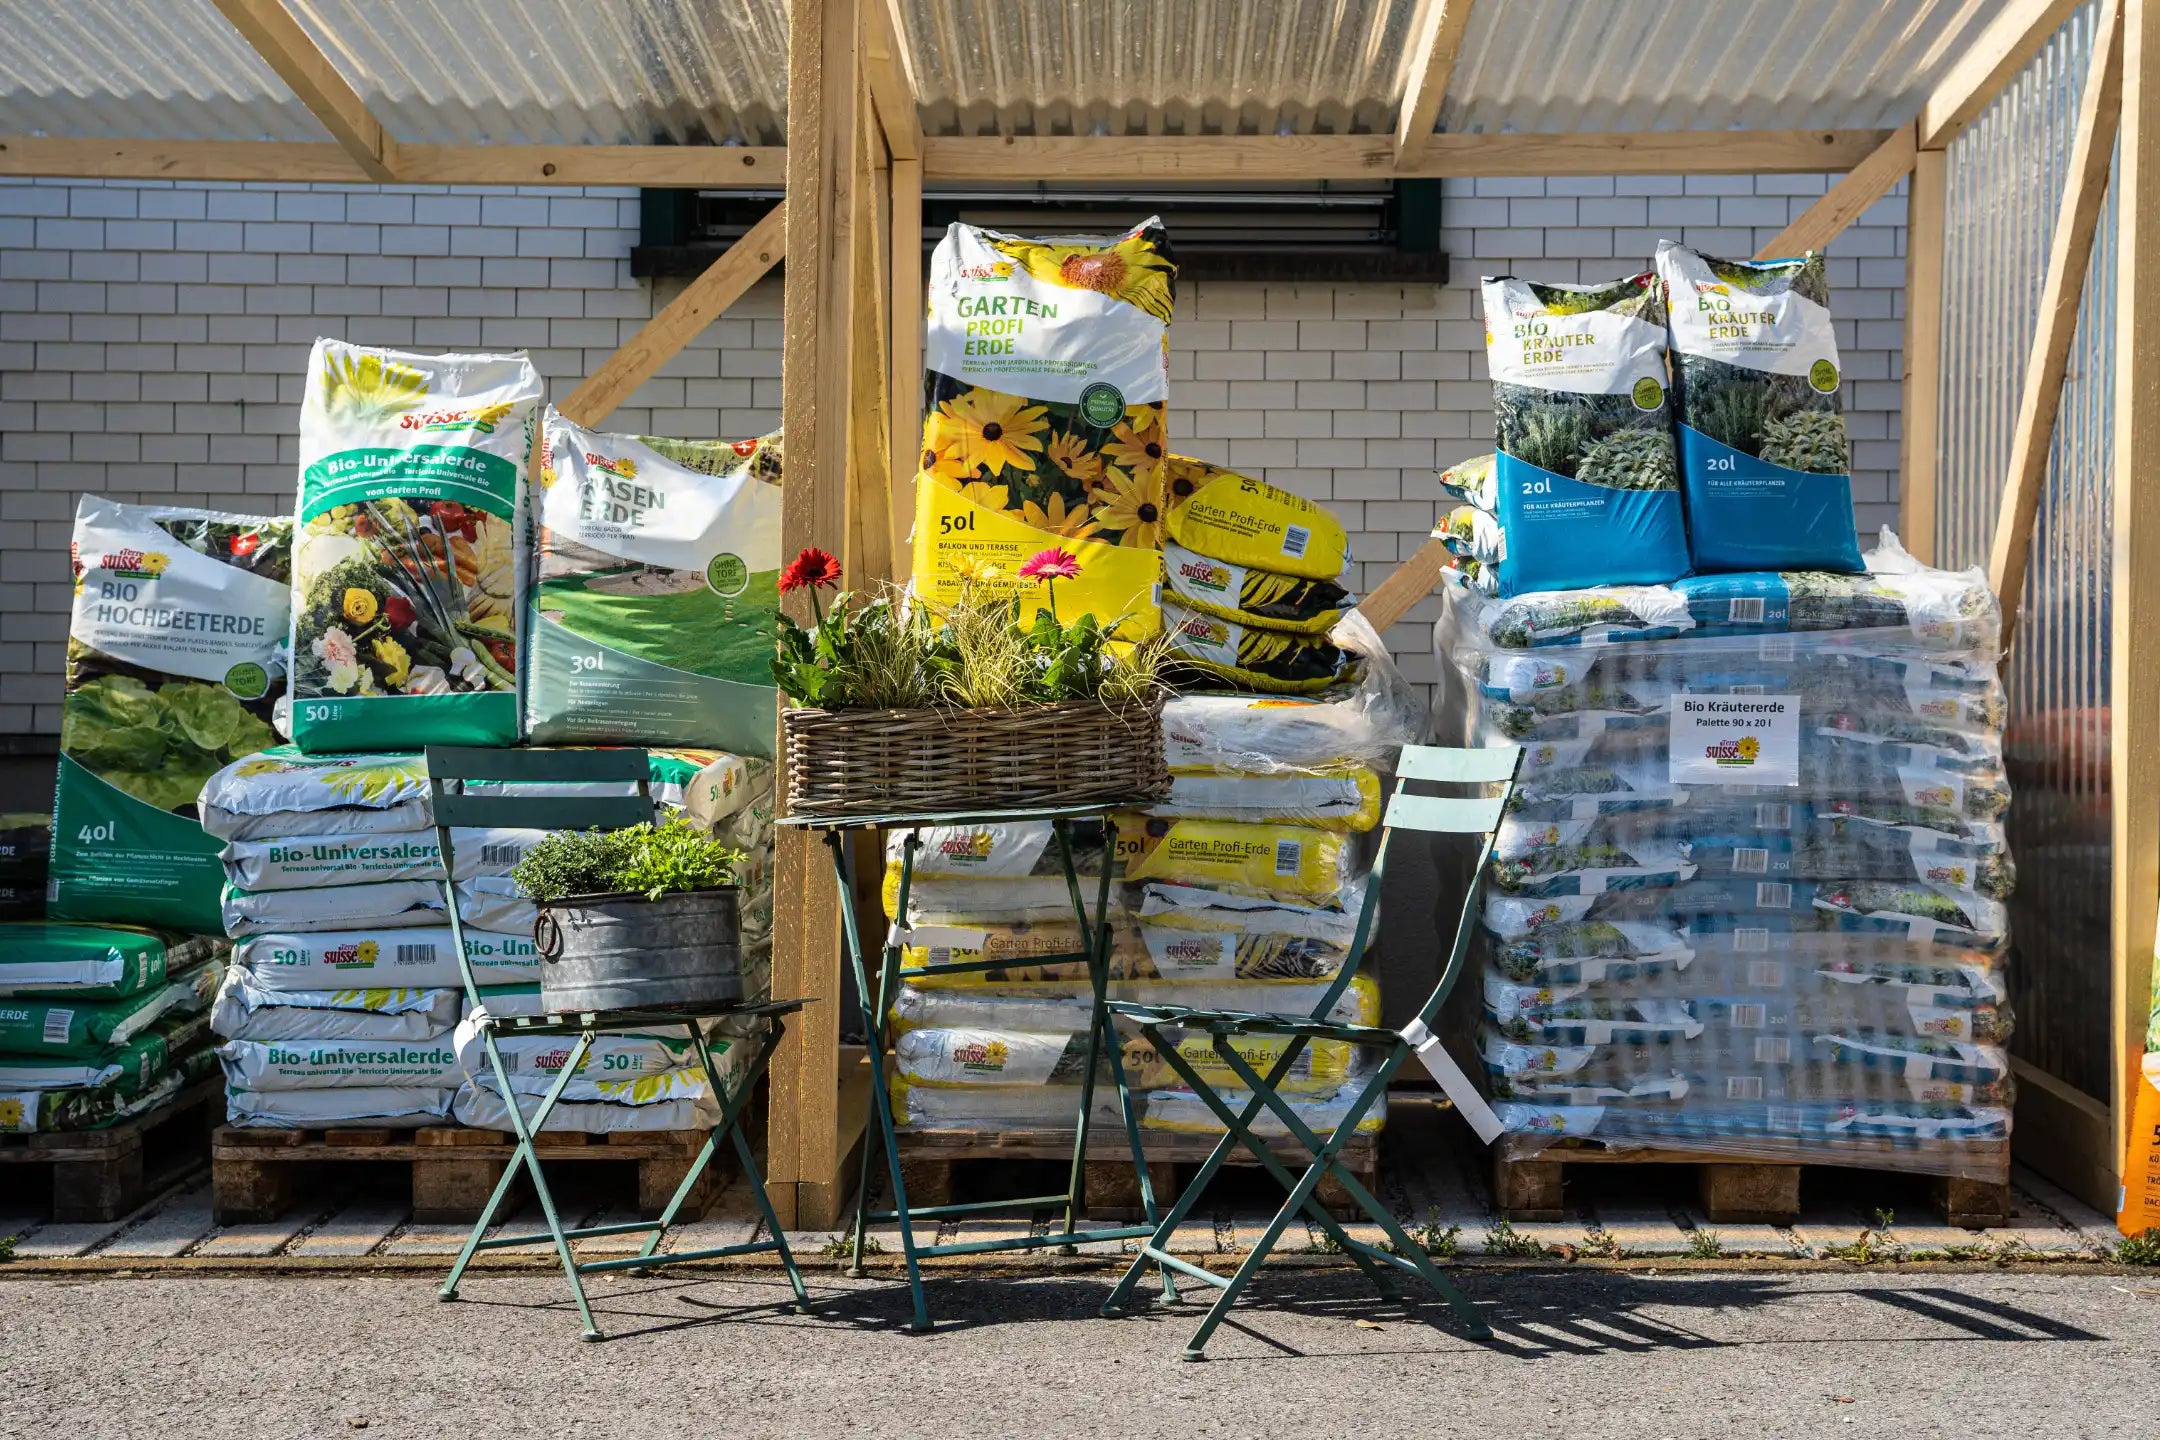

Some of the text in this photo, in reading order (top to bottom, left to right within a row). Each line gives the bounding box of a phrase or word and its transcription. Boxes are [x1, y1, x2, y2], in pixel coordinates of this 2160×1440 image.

[957, 295, 1058, 319] GARTEN
[1708, 311, 1776, 326] KRÄUTER
[966, 318, 1023, 337] PROFI
[1514, 322, 1548, 338] BIO
[1710, 326, 1750, 339] ERDE
[964, 338, 1015, 356] ERDE
[1524, 350, 1564, 365] ERDE
[327, 452, 488, 475] Bio-Universalerde
[585, 452, 617, 471] suisse
[1707, 454, 1736, 470] 20l
[436, 468, 477, 482] Universale
[477, 478, 490, 486] Bio
[386, 486, 417, 494] Garten
[419, 487, 441, 496] Profi
[1522, 477, 1552, 495] 20l
[579, 499, 645, 528] ERDE
[1190, 500, 1226, 518] Garten
[1230, 510, 1281, 535] Profi-Erde
[940, 510, 974, 534] 50l
[938, 542, 967, 550] BALKON
[987, 544, 1019, 552] TERASSE
[100, 554, 142, 571] suisse
[714, 560, 737, 570] OHNE
[1180, 564, 1212, 582] suisse
[101, 582, 138, 602] BIO
[97, 605, 265, 636] HOCHBEETERDE
[1768, 608, 1786, 619] 20l
[570, 650, 604, 675] 30l
[305, 705, 329, 722] 50
[1684, 701, 1784, 713] Bio Kräutererde
[1696, 718, 1730, 727] Palette
[1732, 718, 1744, 727] 90
[1754, 718, 1766, 728] 20
[1705, 746, 1739, 759] suisse
[78, 821, 116, 844] 40l
[1116, 838, 1145, 856] 50l
[1169, 838, 1270, 856] Garten Profi-Erde
[990, 938, 1028, 950] Garten
[274, 950, 297, 966] 50
[324, 950, 358, 964] suisse
[268, 1048, 454, 1065] Bio-Universalerde
[535, 1055, 568, 1069] suisse
[602, 1054, 629, 1070] 50
[1131, 1050, 1160, 1066] 50l
[1236, 1048, 1283, 1061] rofi-Erd
[278, 1068, 306, 1076] Terreau
